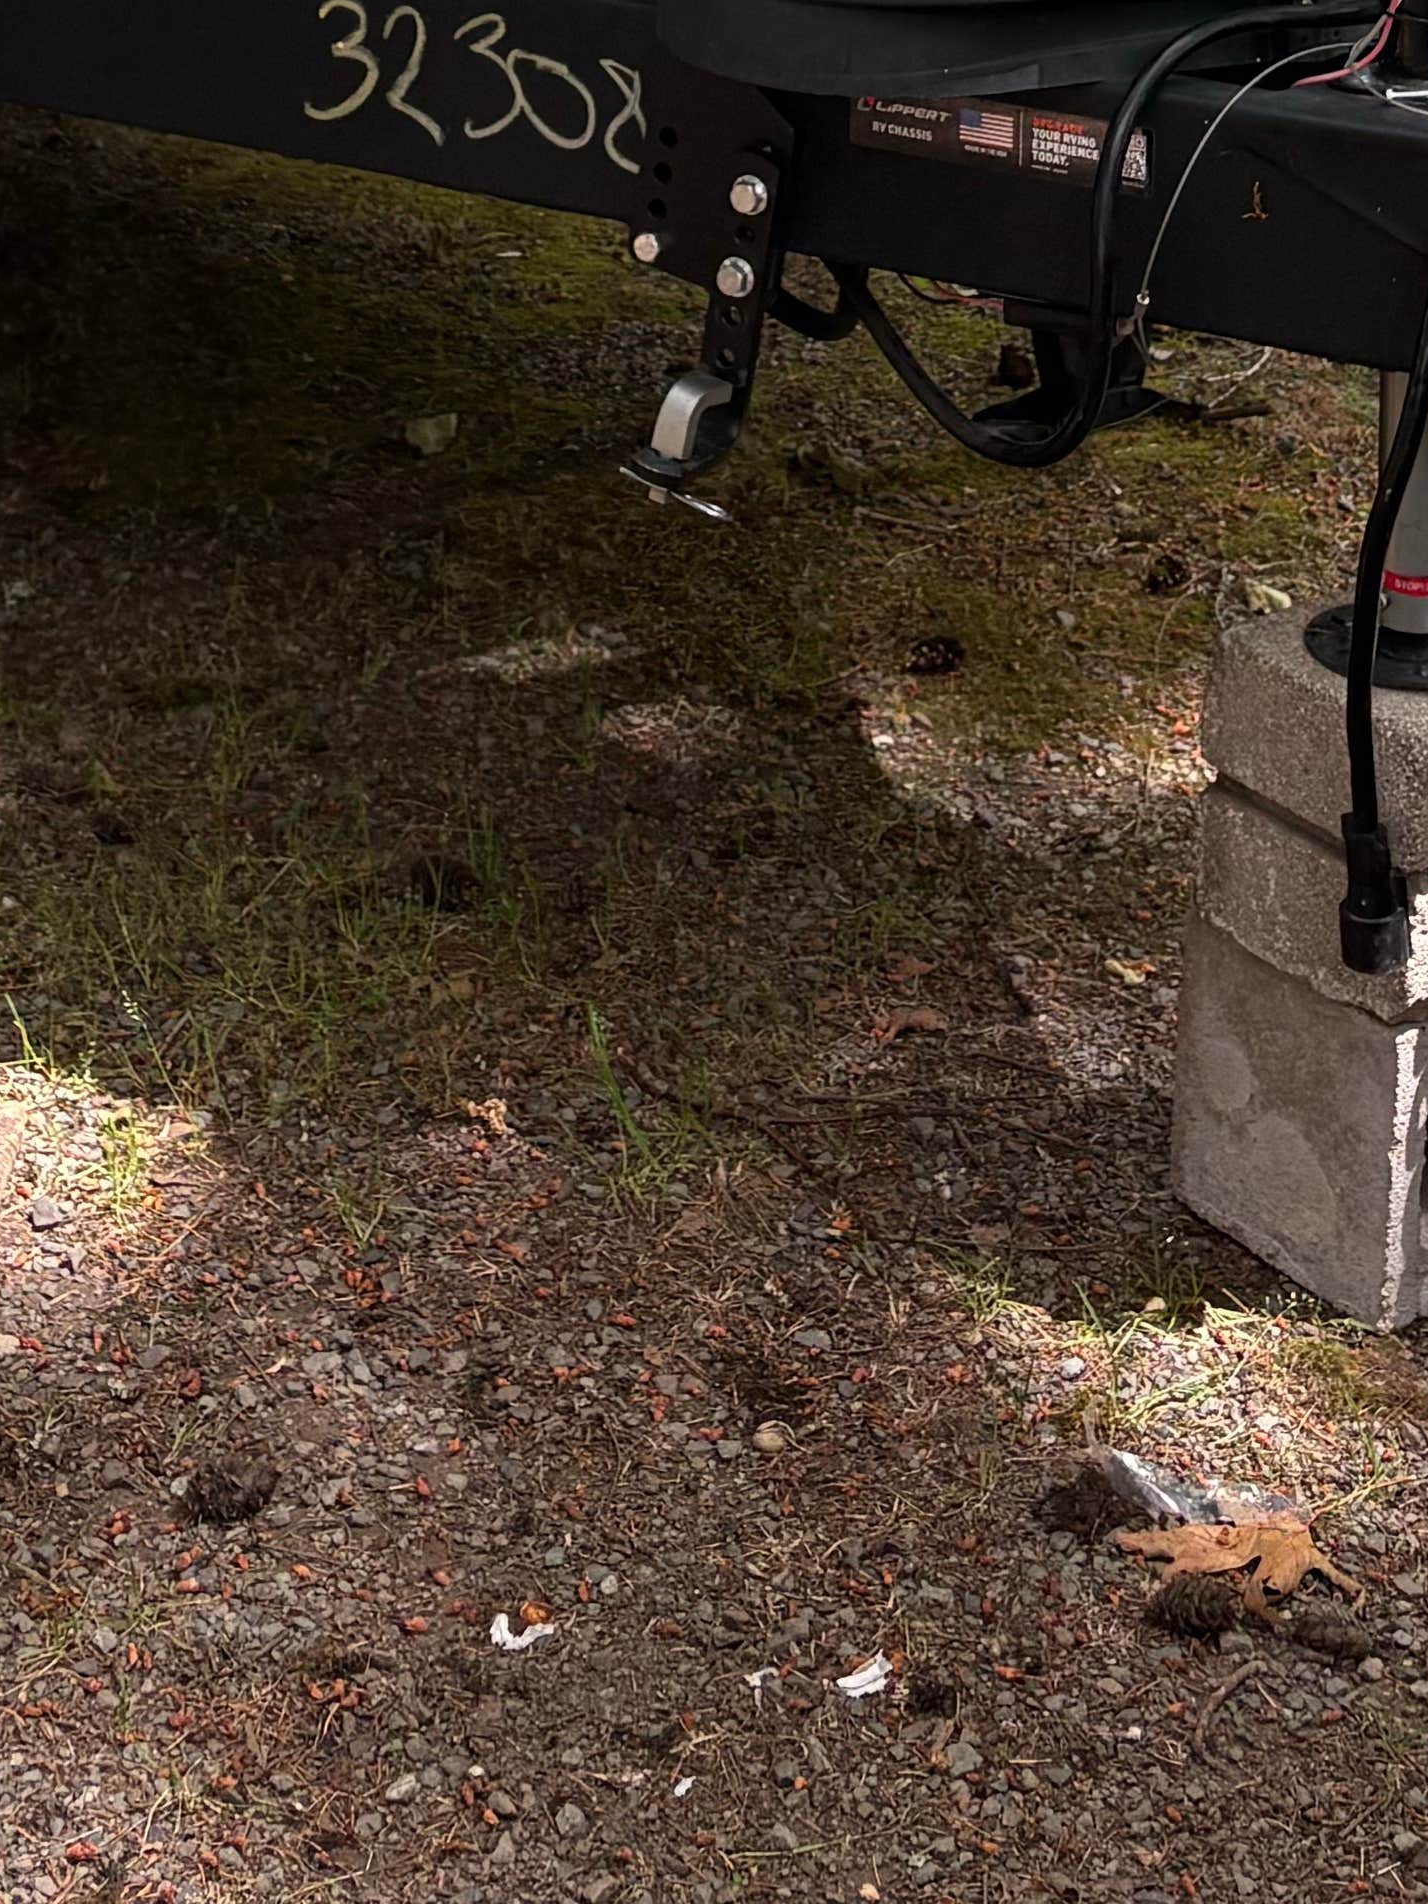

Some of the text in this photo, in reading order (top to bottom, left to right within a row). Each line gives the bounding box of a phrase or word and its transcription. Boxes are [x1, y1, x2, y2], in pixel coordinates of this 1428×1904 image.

[872, 120, 933, 142] RV CHASSIS
[1032, 127, 1096, 149] YOUR RVING
[1032, 138, 1100, 161] EXPERIENCE
